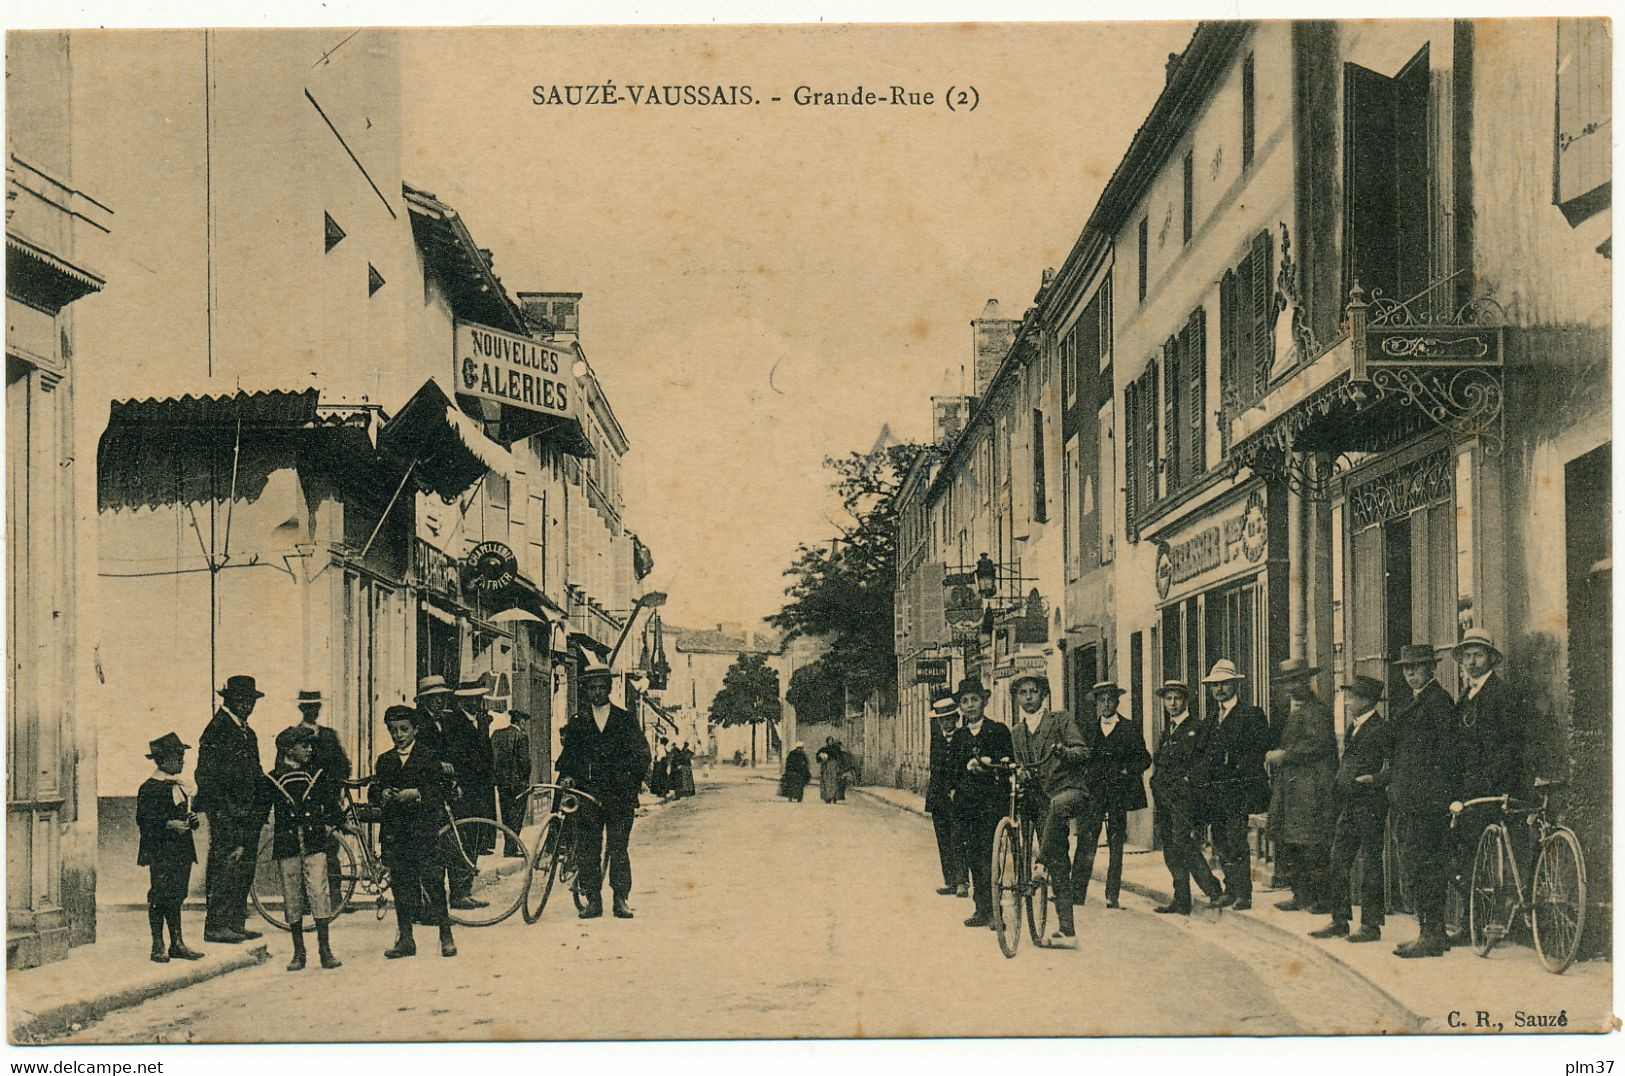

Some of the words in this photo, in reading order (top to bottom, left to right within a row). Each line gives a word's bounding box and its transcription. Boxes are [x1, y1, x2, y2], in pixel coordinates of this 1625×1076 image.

[533, 80, 759, 105] SAUZÉ-VAUSSAIS.
[794, 86, 934, 105] Grande-Rue
[946, 86, 979, 111] (2)
[471, 329, 559, 375] NOUVELLES
[462, 357, 568, 411] GALERIES
[469, 543, 514, 566] CHAPELLERIE
[917, 667, 946, 677] MICHELIN
[1448, 1011, 1466, 1027] C.
